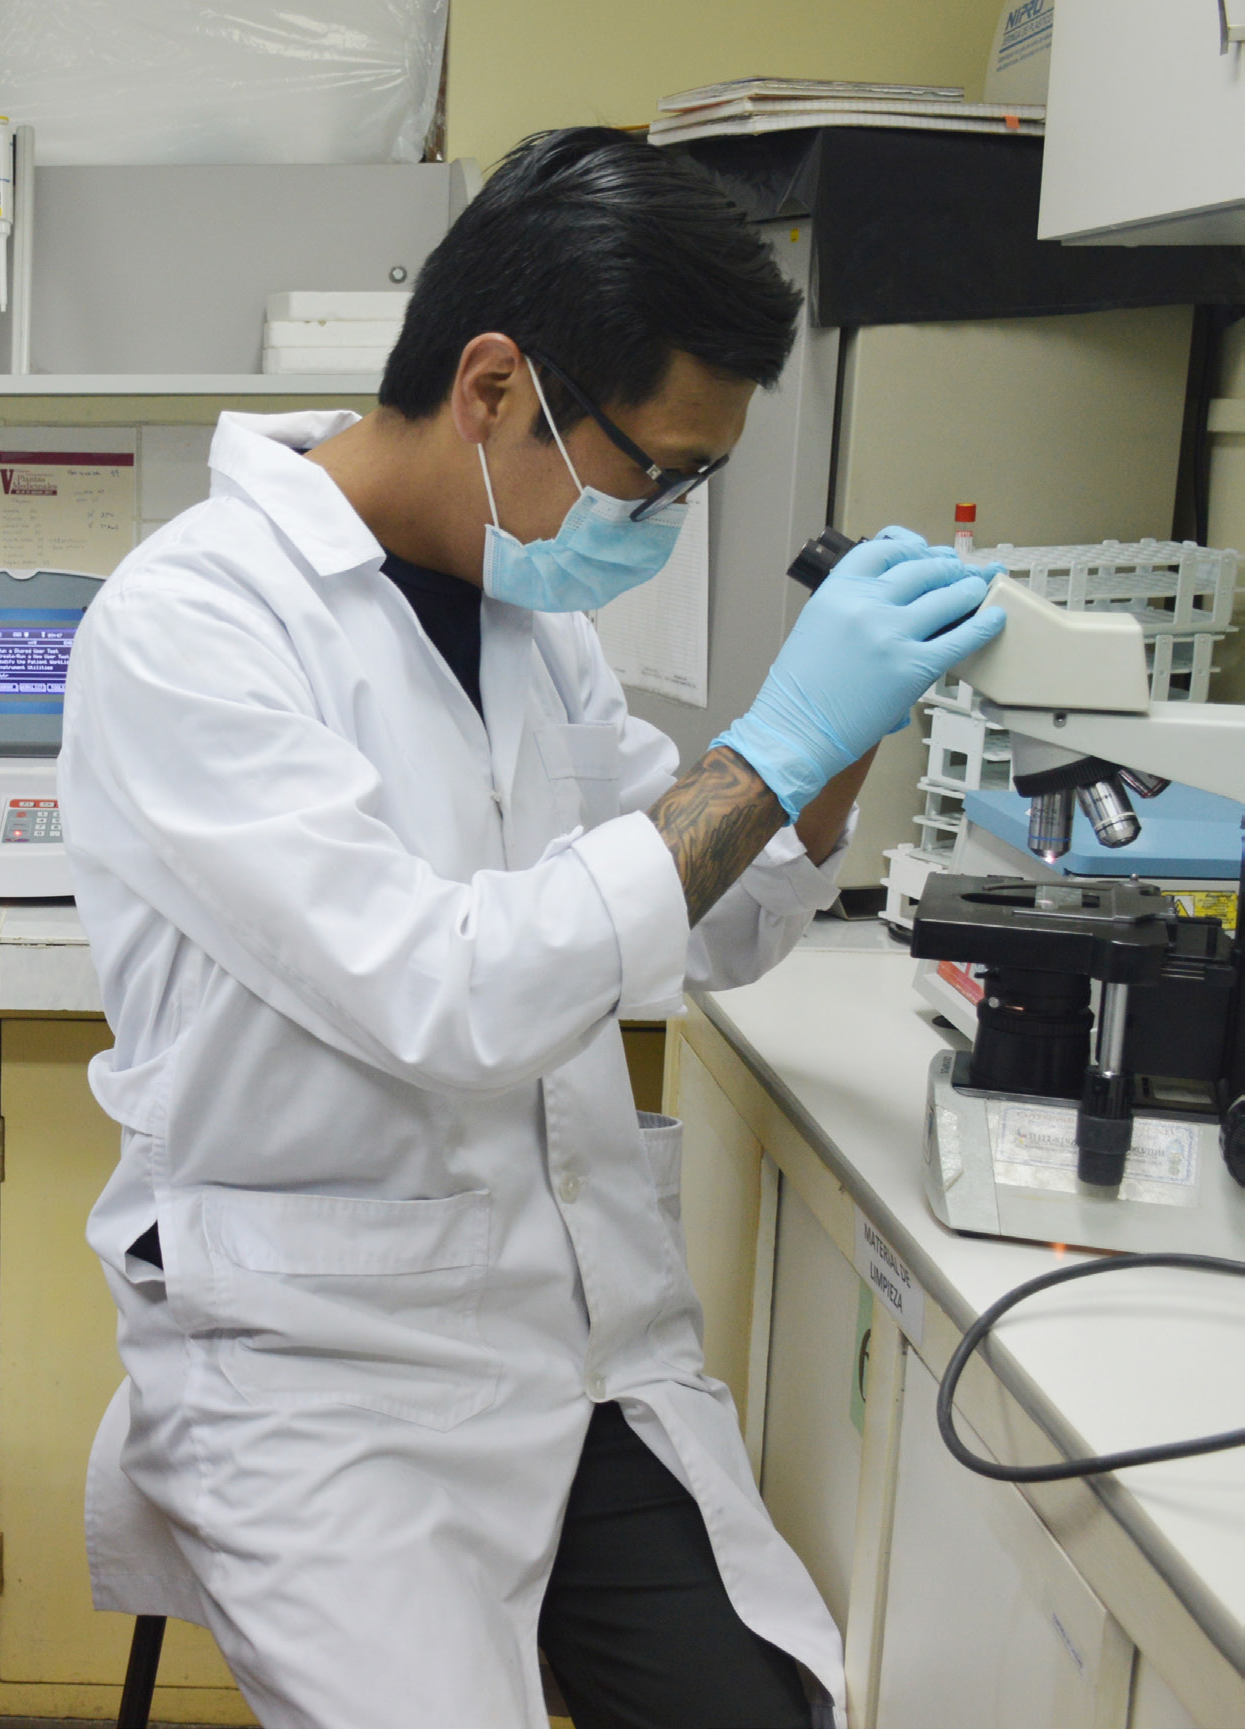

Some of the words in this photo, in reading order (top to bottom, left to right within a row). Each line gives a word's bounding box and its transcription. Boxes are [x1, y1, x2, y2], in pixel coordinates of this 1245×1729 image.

[0, 469, 14, 494] V
[864, 1223, 900, 1276] MATERIAL
[900, 1263, 911, 1289] DE
[870, 1260, 903, 1314] LIMPIEZA
